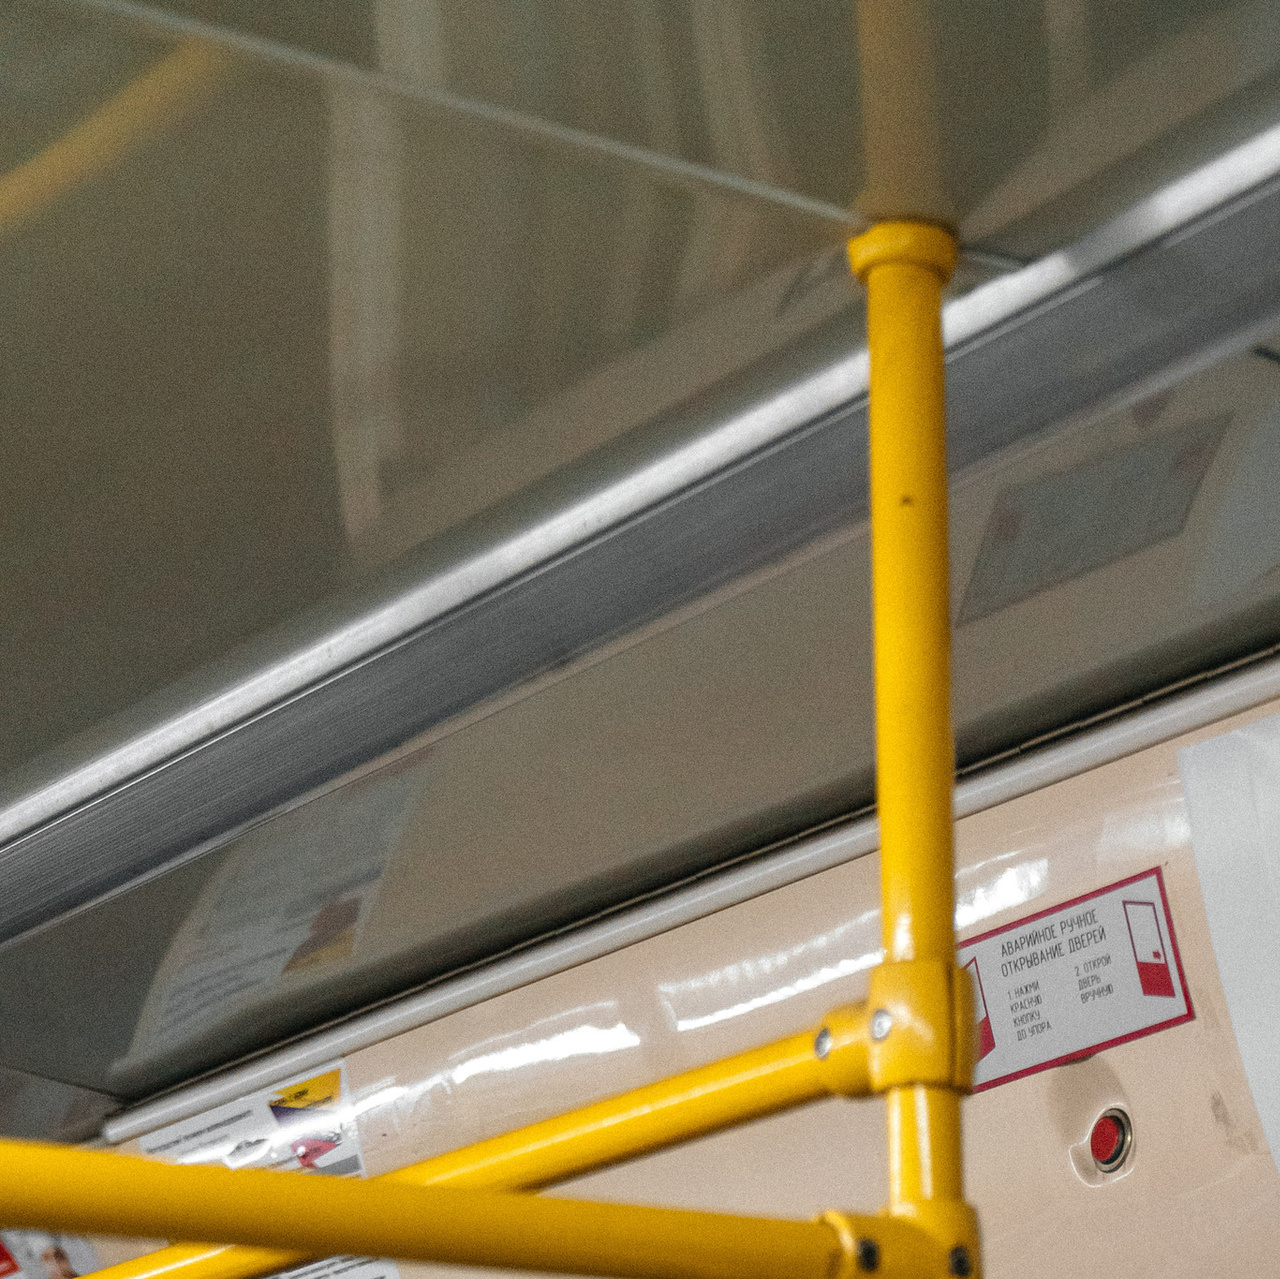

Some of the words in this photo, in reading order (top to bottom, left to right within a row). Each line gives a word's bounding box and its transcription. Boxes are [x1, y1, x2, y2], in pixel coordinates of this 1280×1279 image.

[1000, 924, 1057, 957] АВАРИЙНОЕ
[1060, 909, 1099, 933] РУЧНОЕ
[1001, 945, 1065, 978] ОТКРЫВАНИЕ
[1069, 925, 1107, 955] ДВЕРЕЙ
[1083, 952, 1112, 973] ОТКРОЙ
[1014, 980, 1040, 998] НАЖМИ
[1078, 974, 1101, 991] ДВЕРЬ
[1010, 994, 1043, 1013] КРАСНУЮ
[1080, 983, 1114, 1004] ВРУЧНУЮ
[1012, 1009, 1041, 1027] КНОПКУ
[1016, 1029, 1027, 1041] ДО
[1028, 1020, 1052, 1037] УПОРА
